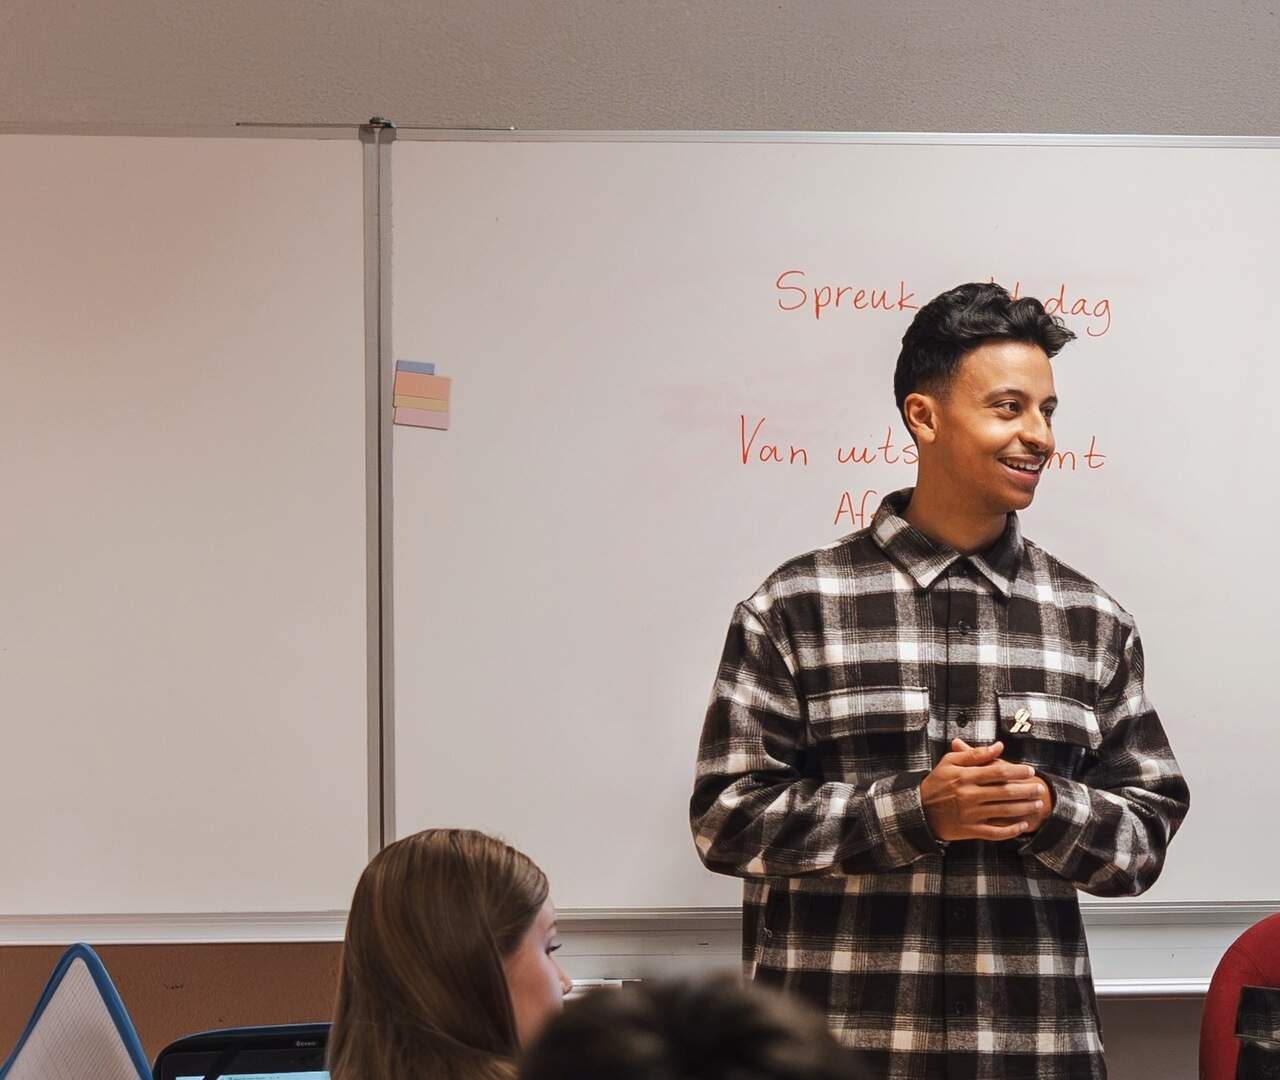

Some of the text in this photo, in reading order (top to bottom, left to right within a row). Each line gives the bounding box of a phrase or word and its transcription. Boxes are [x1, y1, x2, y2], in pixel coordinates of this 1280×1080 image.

[775, 270, 919, 319] Spreuk
[1044, 284, 1112, 337] dag
[738, 414, 808, 465] Van
